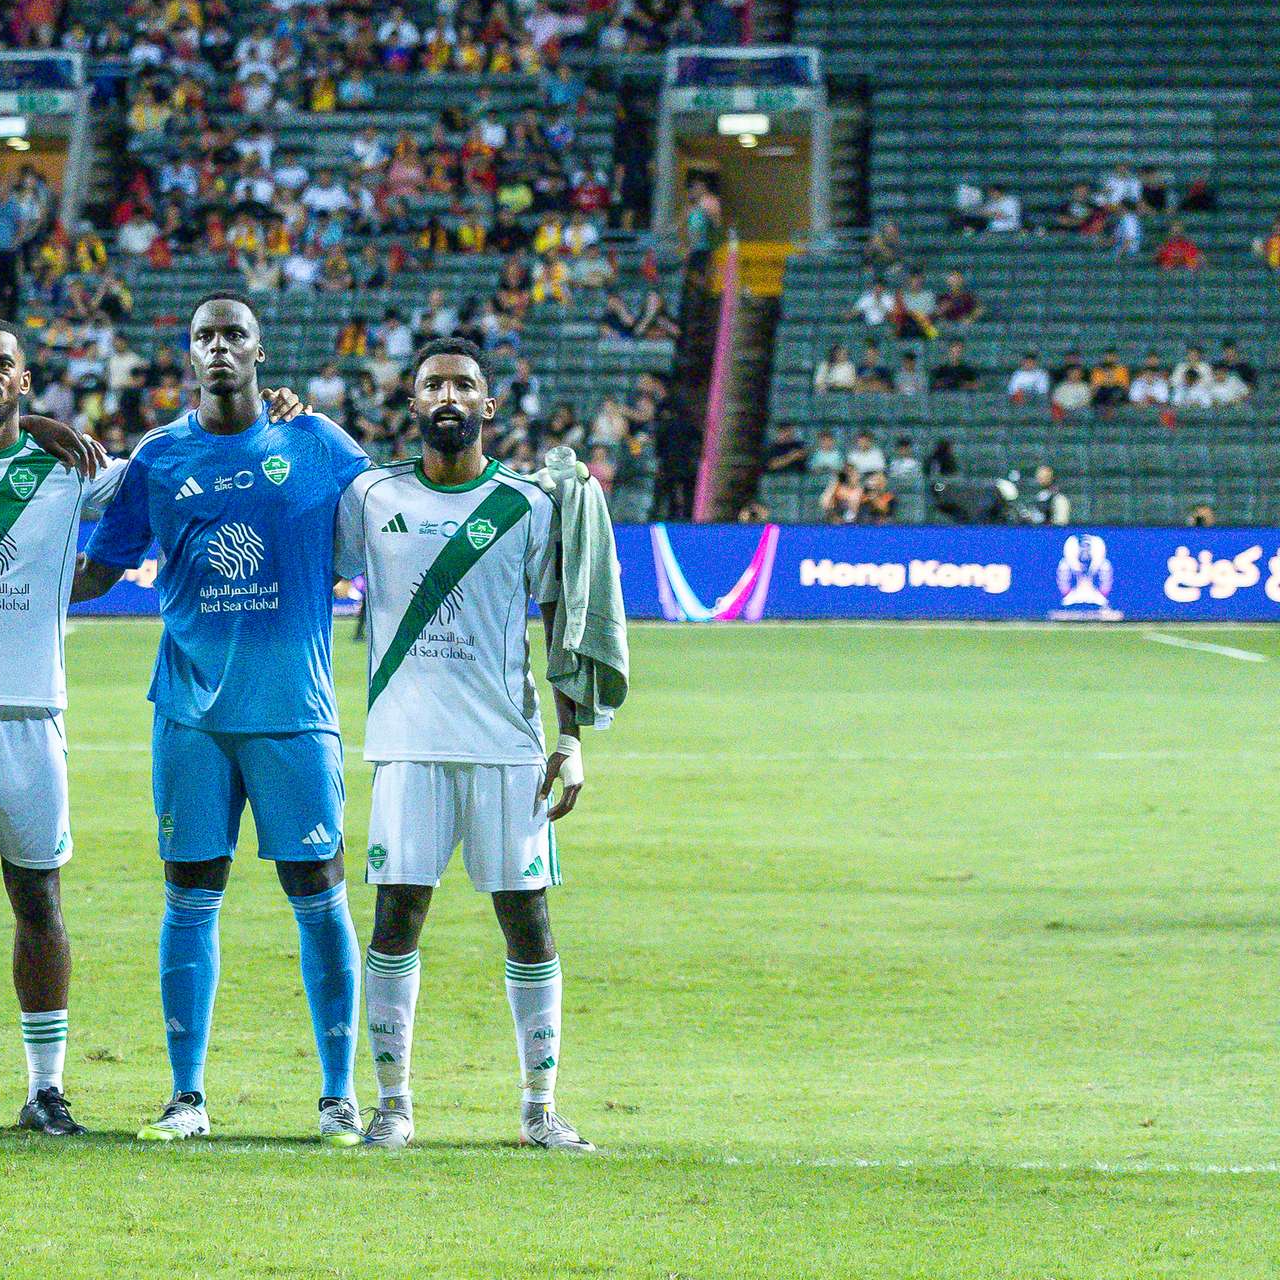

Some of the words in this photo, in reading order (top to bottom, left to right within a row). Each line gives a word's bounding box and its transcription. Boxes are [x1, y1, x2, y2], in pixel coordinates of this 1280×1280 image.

[800, 559, 906, 593] Hong
[908, 559, 1012, 594] Kong
[200, 600, 220, 613] Red
[223, 600, 242, 611] Sea
[244, 598, 279, 611] Global
[420, 647, 438, 658] Sea
